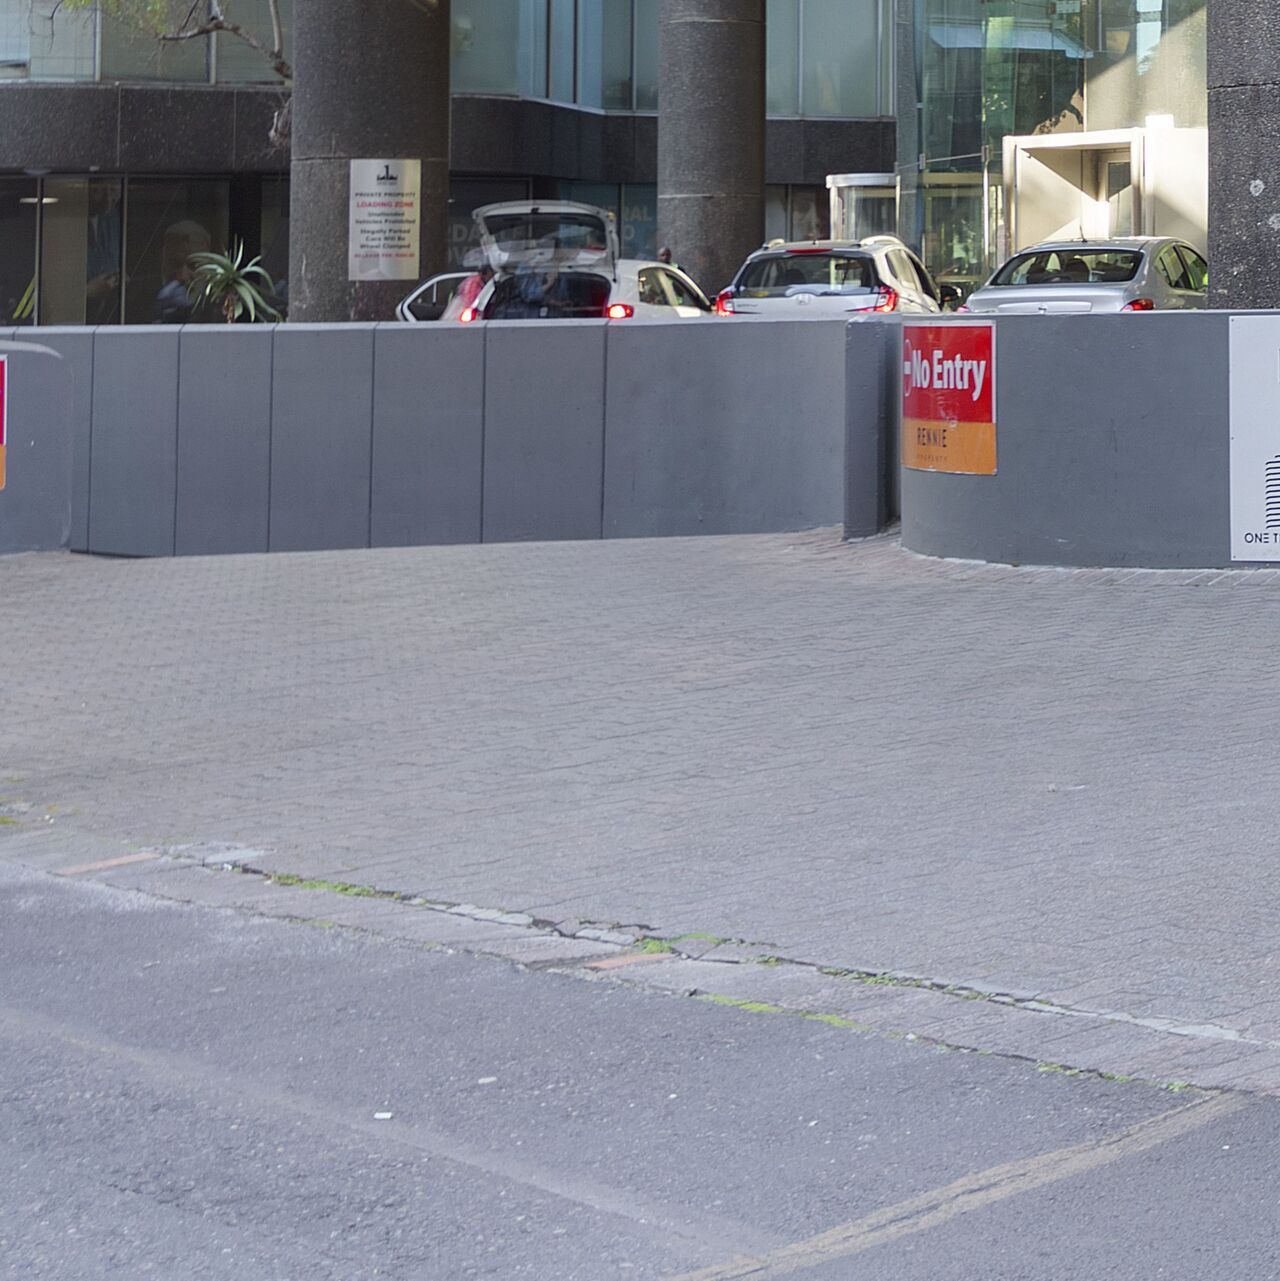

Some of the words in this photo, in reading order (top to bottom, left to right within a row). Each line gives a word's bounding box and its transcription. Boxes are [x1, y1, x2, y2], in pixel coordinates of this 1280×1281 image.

[912, 350, 930, 388] No
[932, 349, 986, 402] Entry
[917, 427, 947, 448] RENNIE
[1244, 532, 1270, 544] ONE
